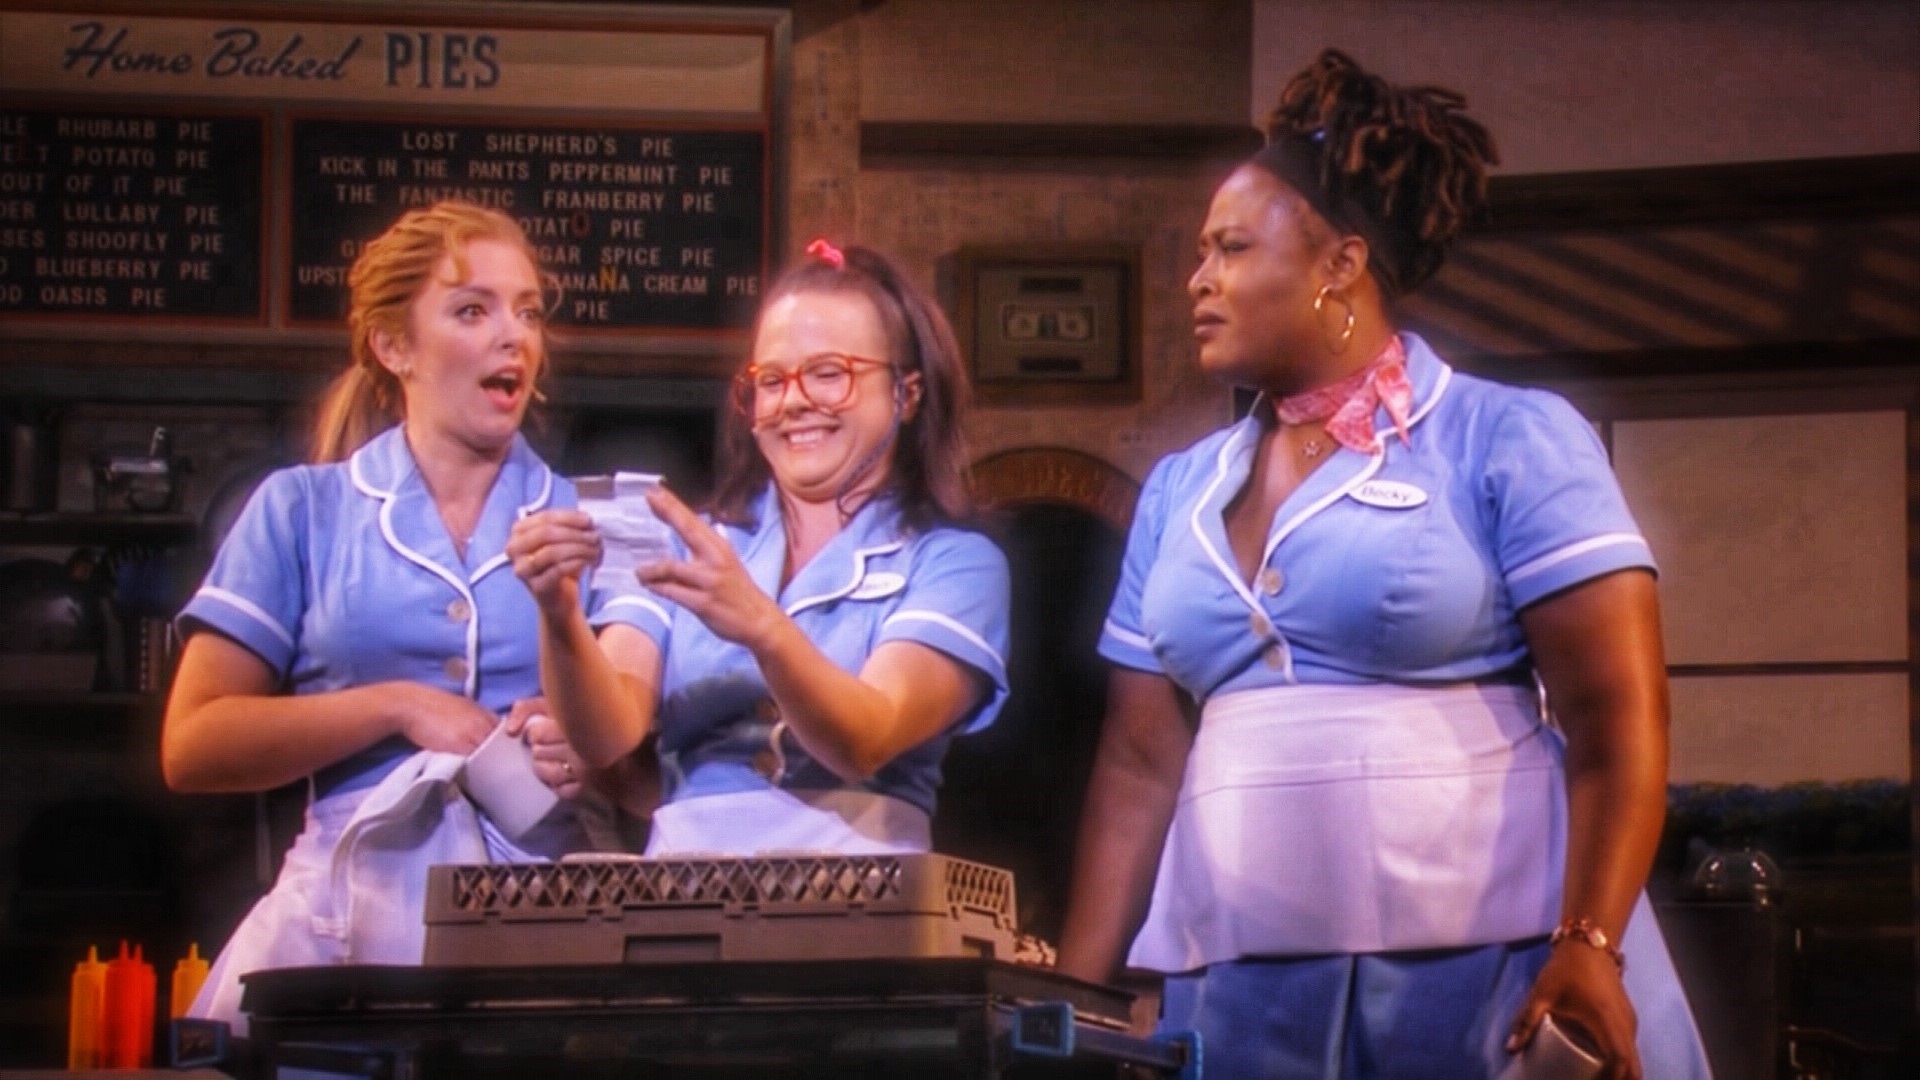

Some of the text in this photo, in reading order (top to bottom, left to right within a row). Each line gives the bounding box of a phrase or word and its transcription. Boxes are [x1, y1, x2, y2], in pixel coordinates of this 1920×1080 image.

[63, 21, 500, 89] Home Baked PIES
[0, 115, 212, 142] LE RHUBARB PIE
[401, 131, 674, 158] LOST SHEPHERD'S PIE
[72, 146, 156, 167] POTATO
[175, 149, 209, 169] PIE
[320, 156, 733, 186] KICK IN THE PANTS PEPPERMINT PIE
[2, 173, 187, 197] OUT OF IT PIE
[335, 184, 716, 213] THE FANTASTIC FRANBERRY PIE
[62, 203, 160, 222] LULLABY
[184, 205, 220, 225] PIE
[519, 211, 646, 239] OTATO PIE
[66, 231, 168, 252] SHOOFLY
[189, 233, 224, 254] PIE
[538, 244, 581, 265] GAR
[600, 246, 662, 266] SPICE
[682, 247, 716, 267] PIE
[35, 257, 211, 281] BLUEBERRY PIE
[298, 266, 347, 285] UPST
[644, 273, 707, 295] CREAM
[726, 275, 759, 296] PIE
[40, 286, 107, 305] OASIS
[131, 288, 167, 308] PIE
[574, 300, 609, 320] PIE
